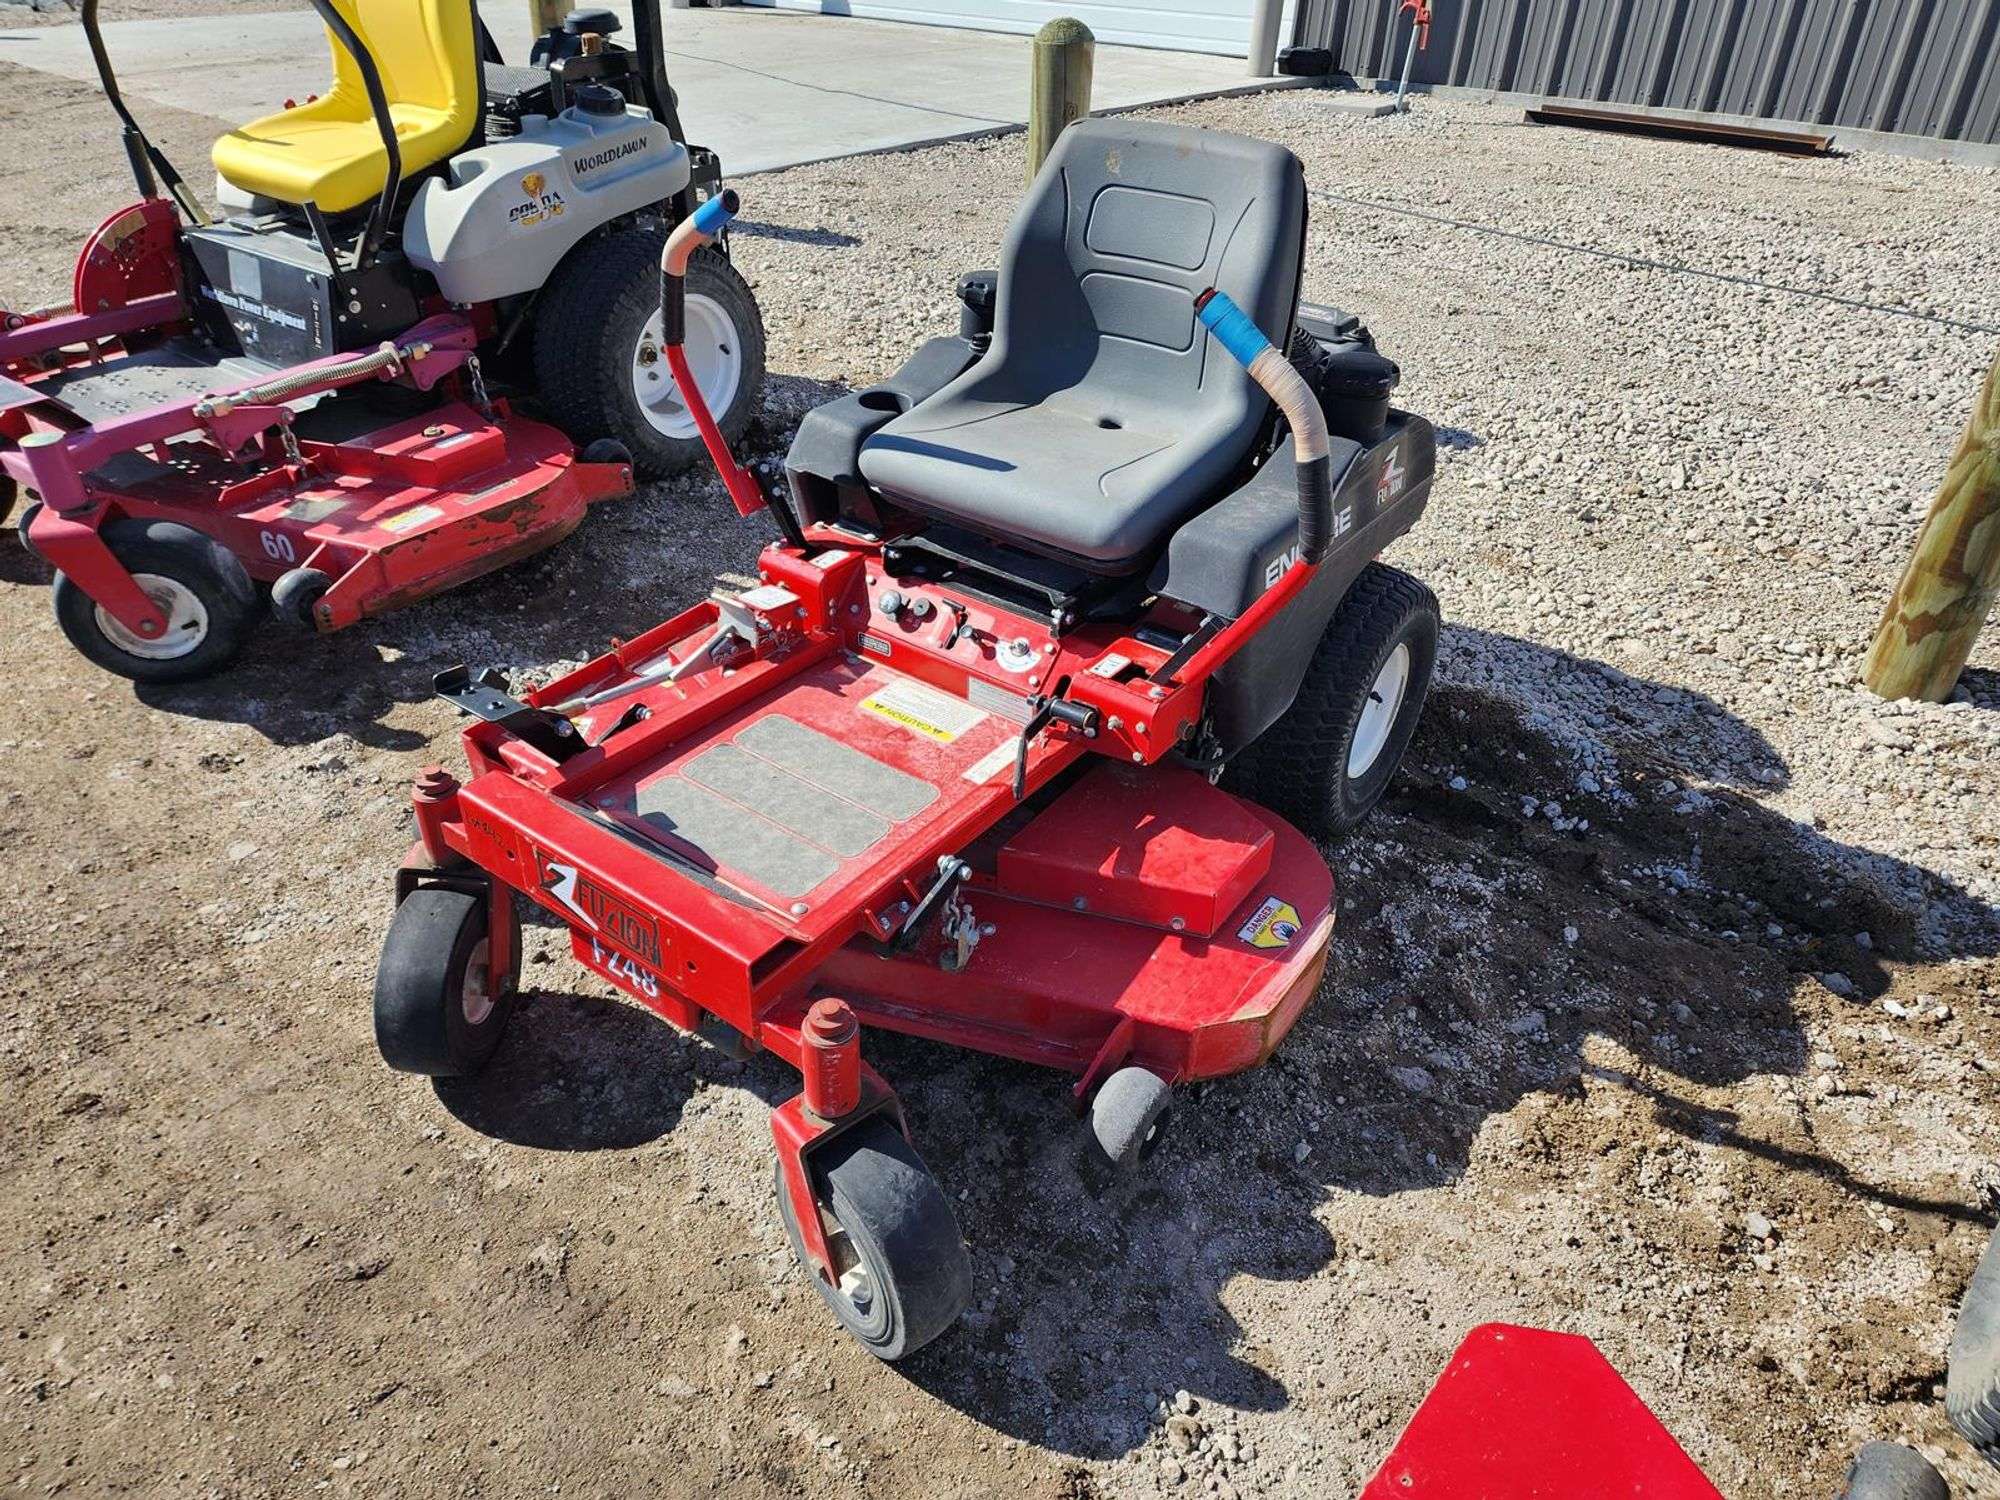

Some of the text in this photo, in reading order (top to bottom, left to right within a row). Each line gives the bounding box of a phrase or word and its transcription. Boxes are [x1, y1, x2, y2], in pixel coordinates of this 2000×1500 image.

[573, 137, 648, 174] WORLDLAWN
[238, 296, 263, 317] Power
[262, 304, 307, 331] Equipment
[260, 530, 296, 563] 60
[886, 706, 932, 731] CAUTION
[1246, 905, 1273, 933] DANGER
